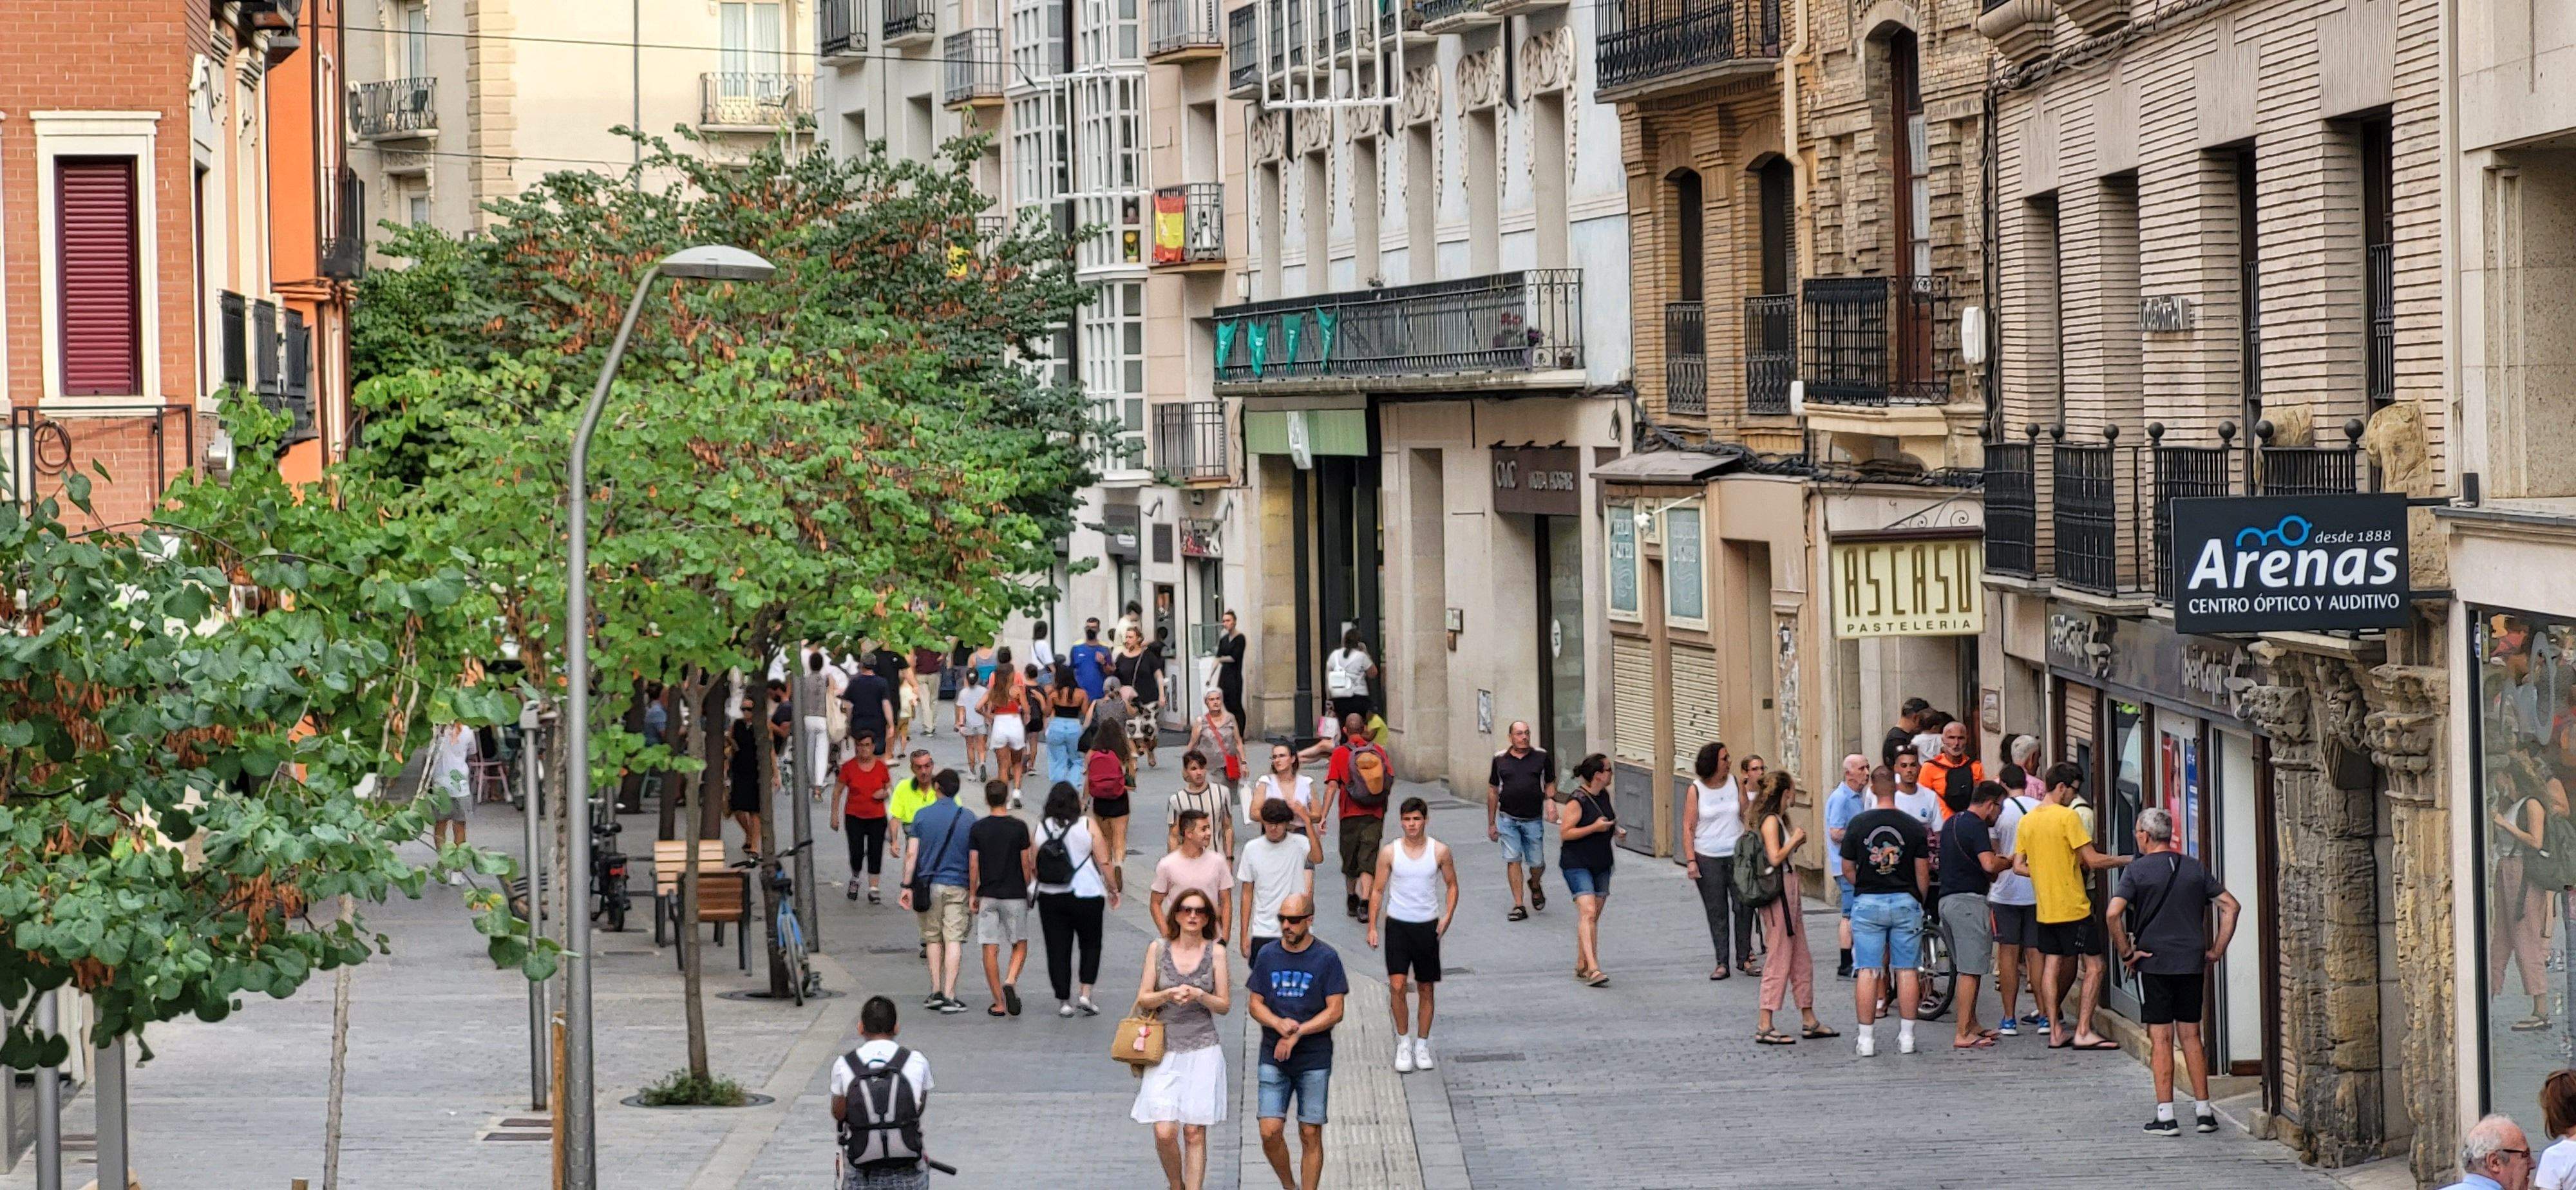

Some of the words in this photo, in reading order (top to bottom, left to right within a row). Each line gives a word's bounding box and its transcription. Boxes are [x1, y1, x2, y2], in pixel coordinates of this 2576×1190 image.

[2315, 531, 2354, 544] desde
[2357, 529, 2392, 543] 1888
[2188, 538, 2400, 589] Arenas
[1844, 543, 1972, 617] ASCASO
[2188, 597, 2249, 614] CENTRO
[2254, 592, 2311, 612] ÓPTICO
[2315, 595, 2325, 610] Y
[2329, 593, 2400, 610] AUDITIVO
[1847, 619, 1971, 633] PASTELERIA
[1271, 970, 1313, 989] PEPE
